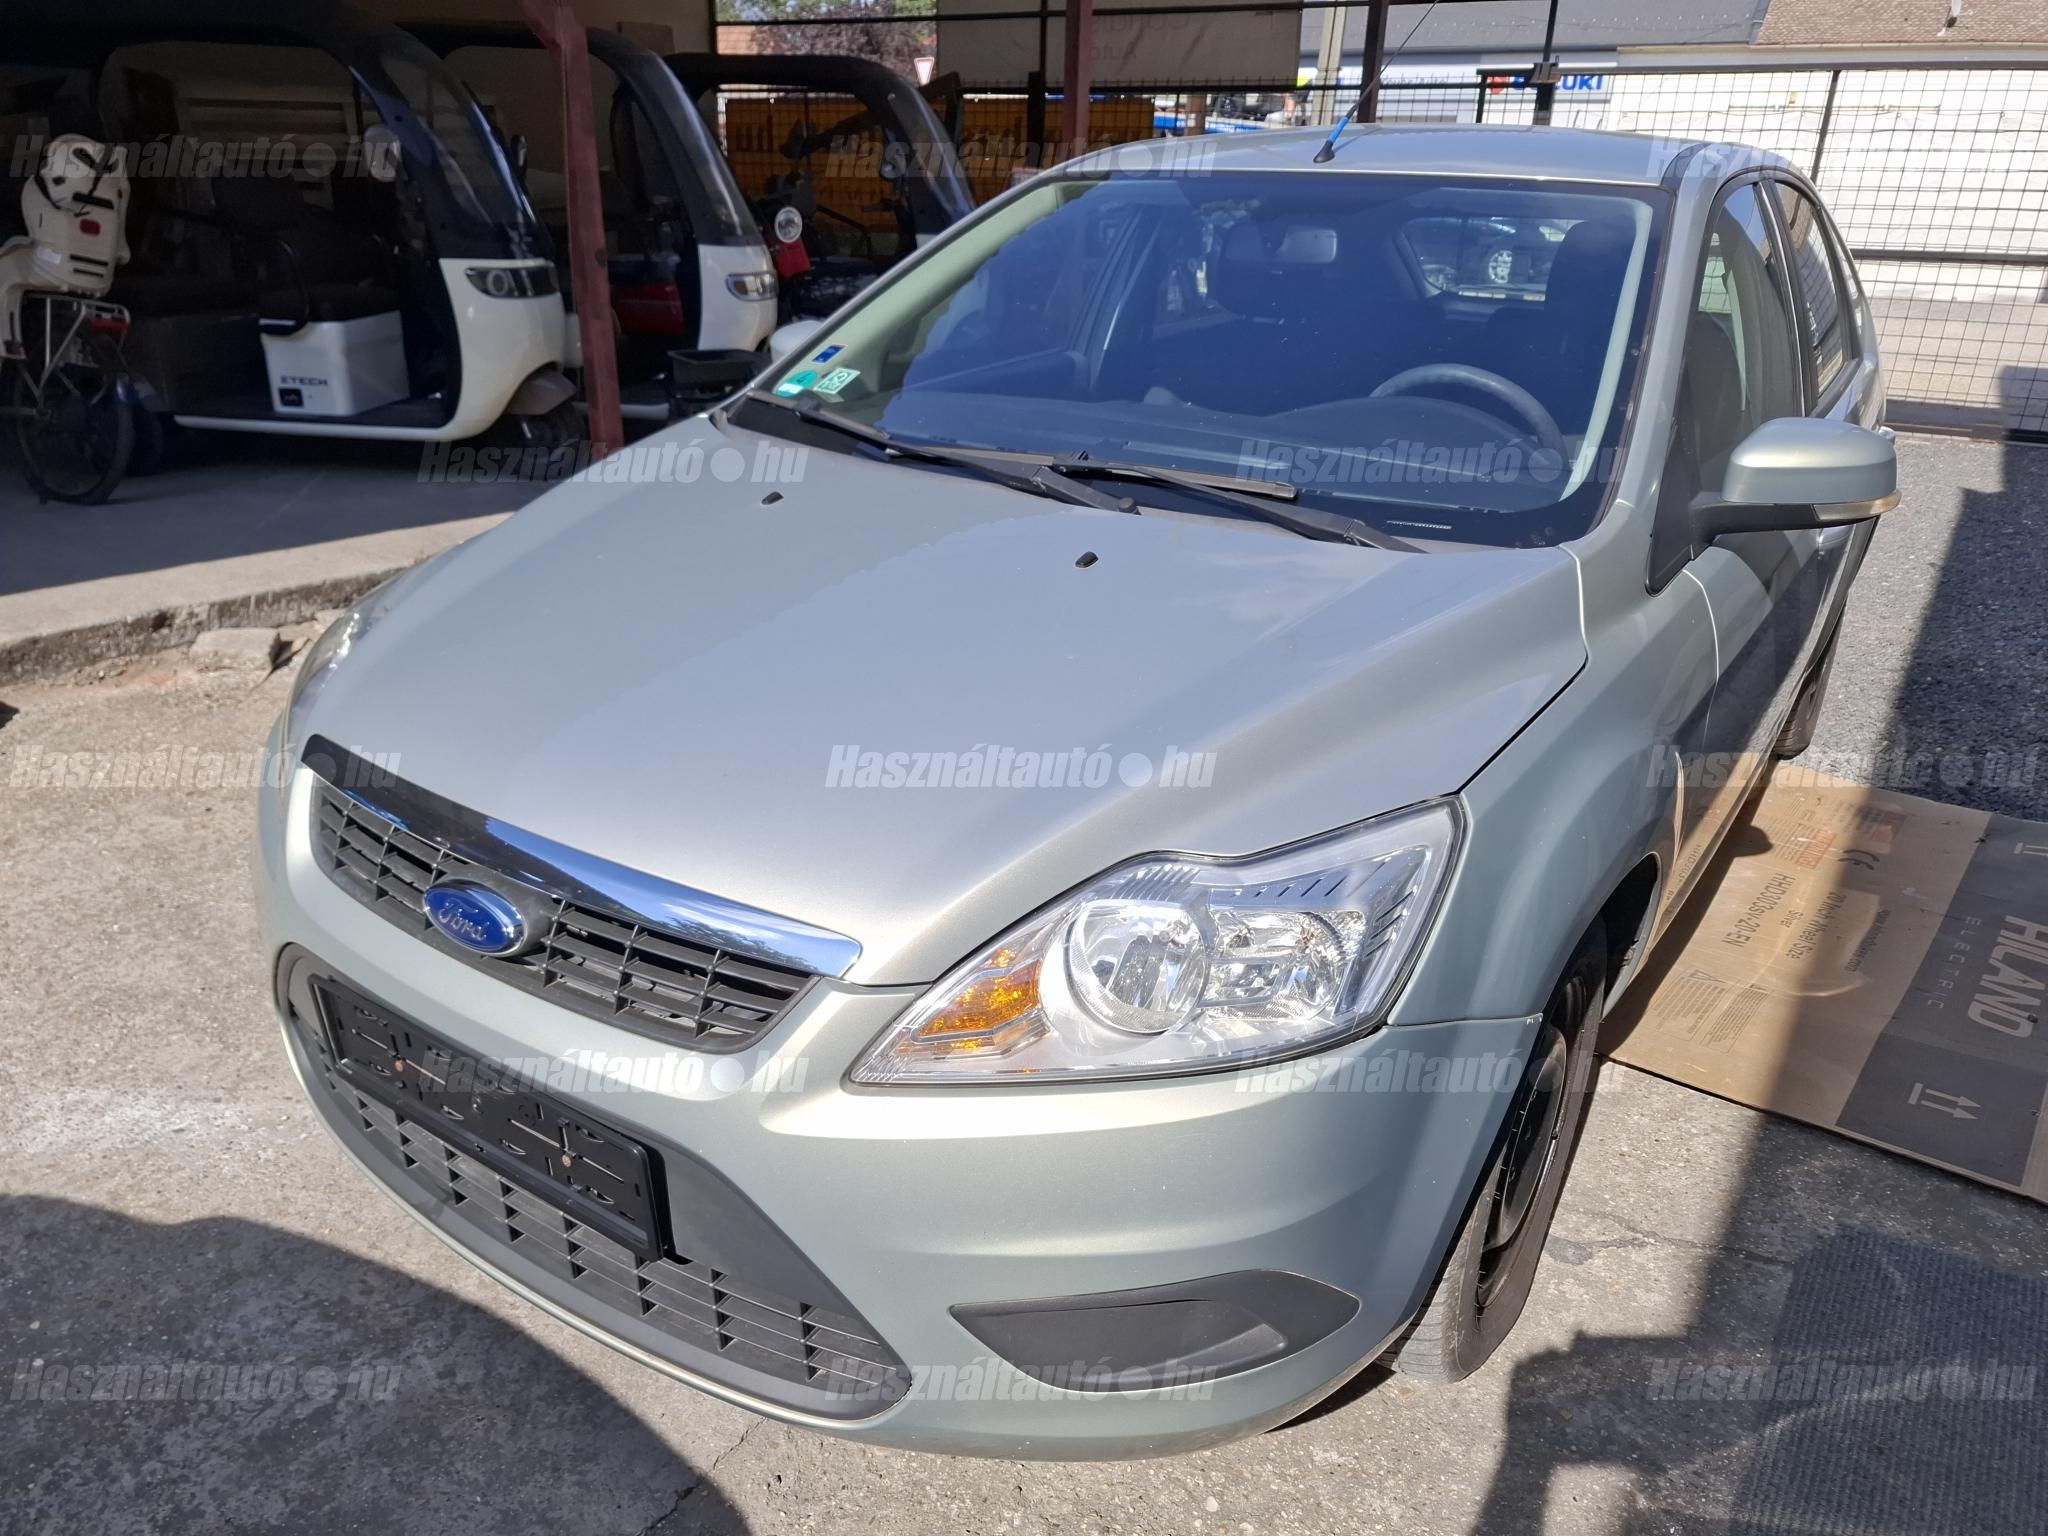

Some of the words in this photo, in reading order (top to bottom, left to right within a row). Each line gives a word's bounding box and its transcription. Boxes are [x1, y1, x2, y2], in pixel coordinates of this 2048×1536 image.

[1506, 74, 1603, 90] SUKI
[439, 897, 488, 941] Ford
[1927, 916, 1982, 1009] ELECTRIC
[1967, 914, 2048, 1038] HILAND
